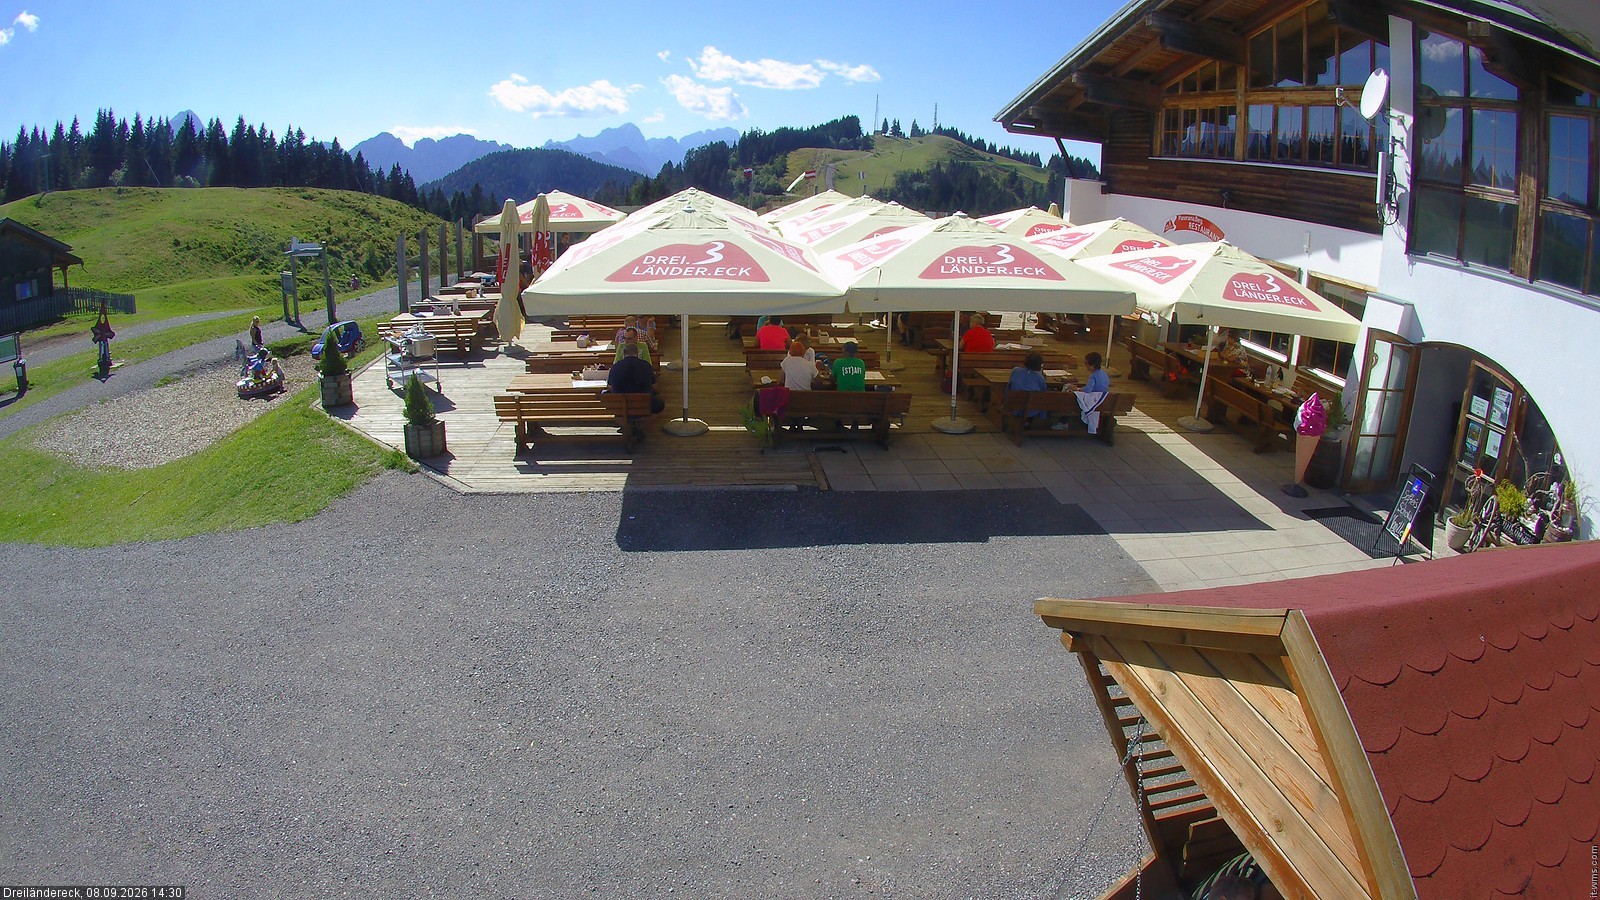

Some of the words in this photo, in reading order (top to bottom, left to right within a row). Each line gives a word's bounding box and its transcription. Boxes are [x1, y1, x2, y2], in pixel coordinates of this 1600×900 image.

[643, 255, 690, 265] DREI.
[944, 256, 988, 264] DREI.
[632, 264, 752, 277] LÄNDER.ECK
[940, 263, 1046, 276] LÄNDER.ECK
[1231, 279, 1264, 293] DREI.
[1233, 287, 1307, 307] LÄNDER.ECK
